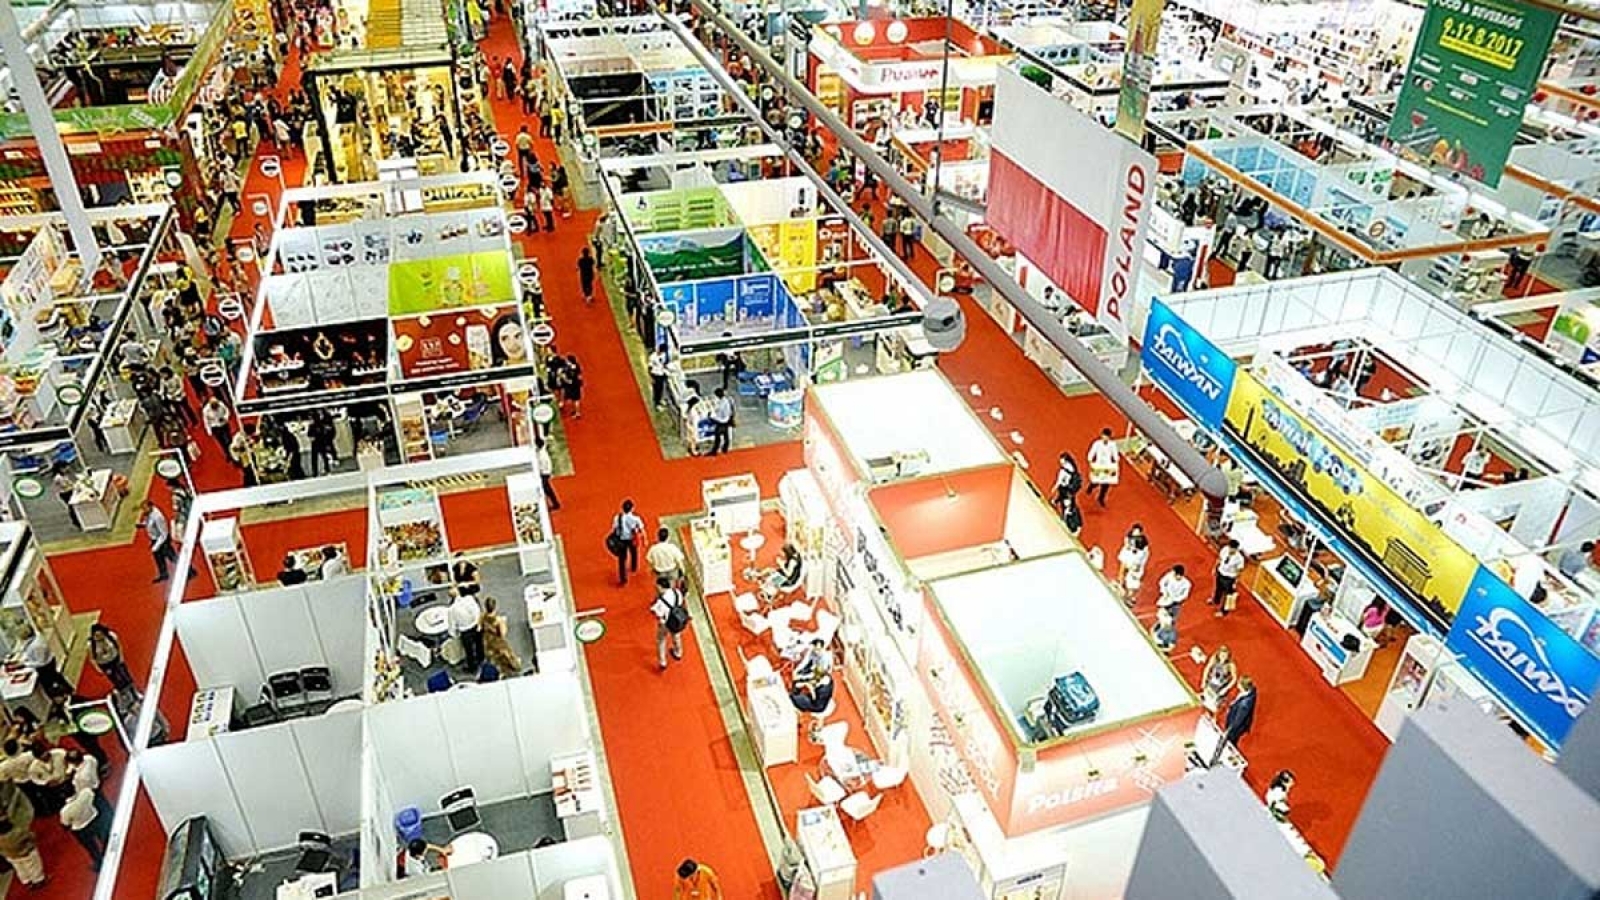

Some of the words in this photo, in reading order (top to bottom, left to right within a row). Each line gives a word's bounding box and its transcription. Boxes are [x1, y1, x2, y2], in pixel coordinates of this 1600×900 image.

[1487, 31, 1524, 58] 2017
[1107, 164, 1145, 322] POLAND
[1152, 323, 1223, 400] TAIWAN
[1475, 607, 1588, 719] TAIWA
